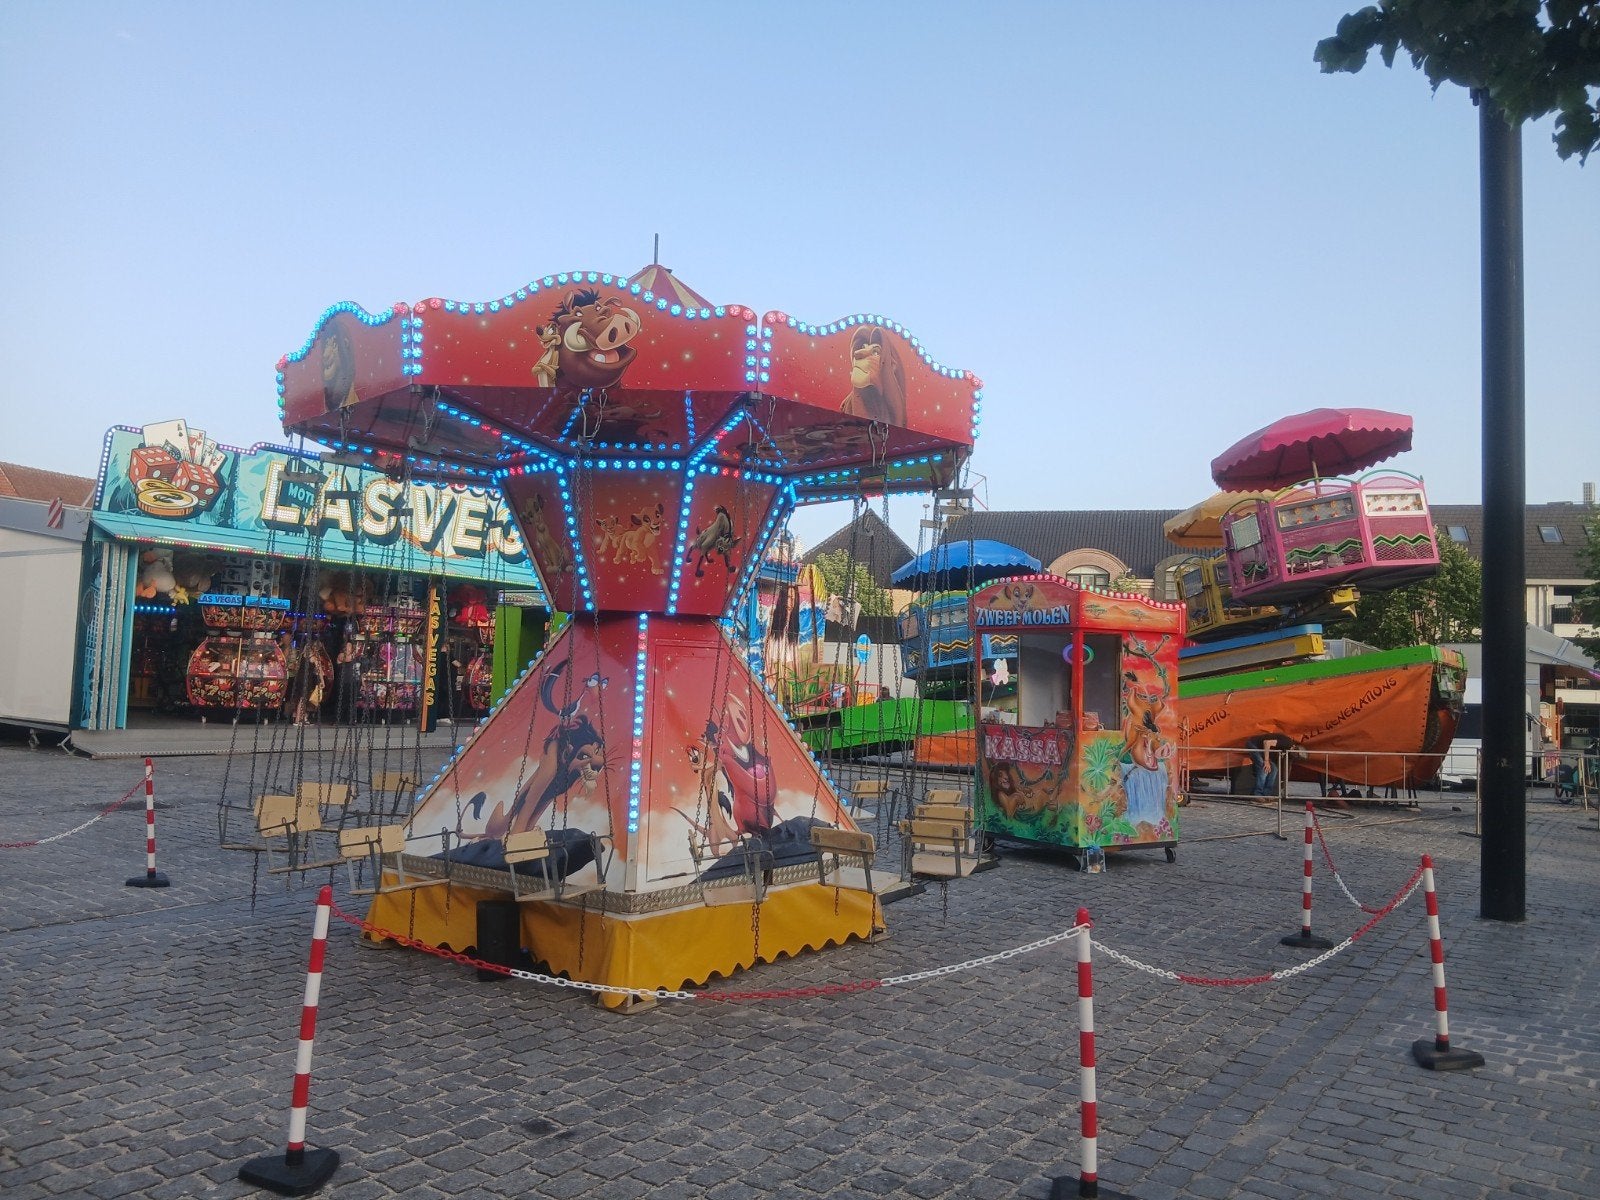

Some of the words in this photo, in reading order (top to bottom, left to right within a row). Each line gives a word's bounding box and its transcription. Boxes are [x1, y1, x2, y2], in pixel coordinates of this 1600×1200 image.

[261, 460, 400, 537] LAS
[215, 595, 242, 604] VEGAS
[430, 587, 441, 630] LAS
[425, 633, 440, 706] VEGAS
[1300, 729, 1324, 743] ALL
[1325, 677, 1397, 731] GENERATIONS
[985, 735, 1062, 765] KASSA
